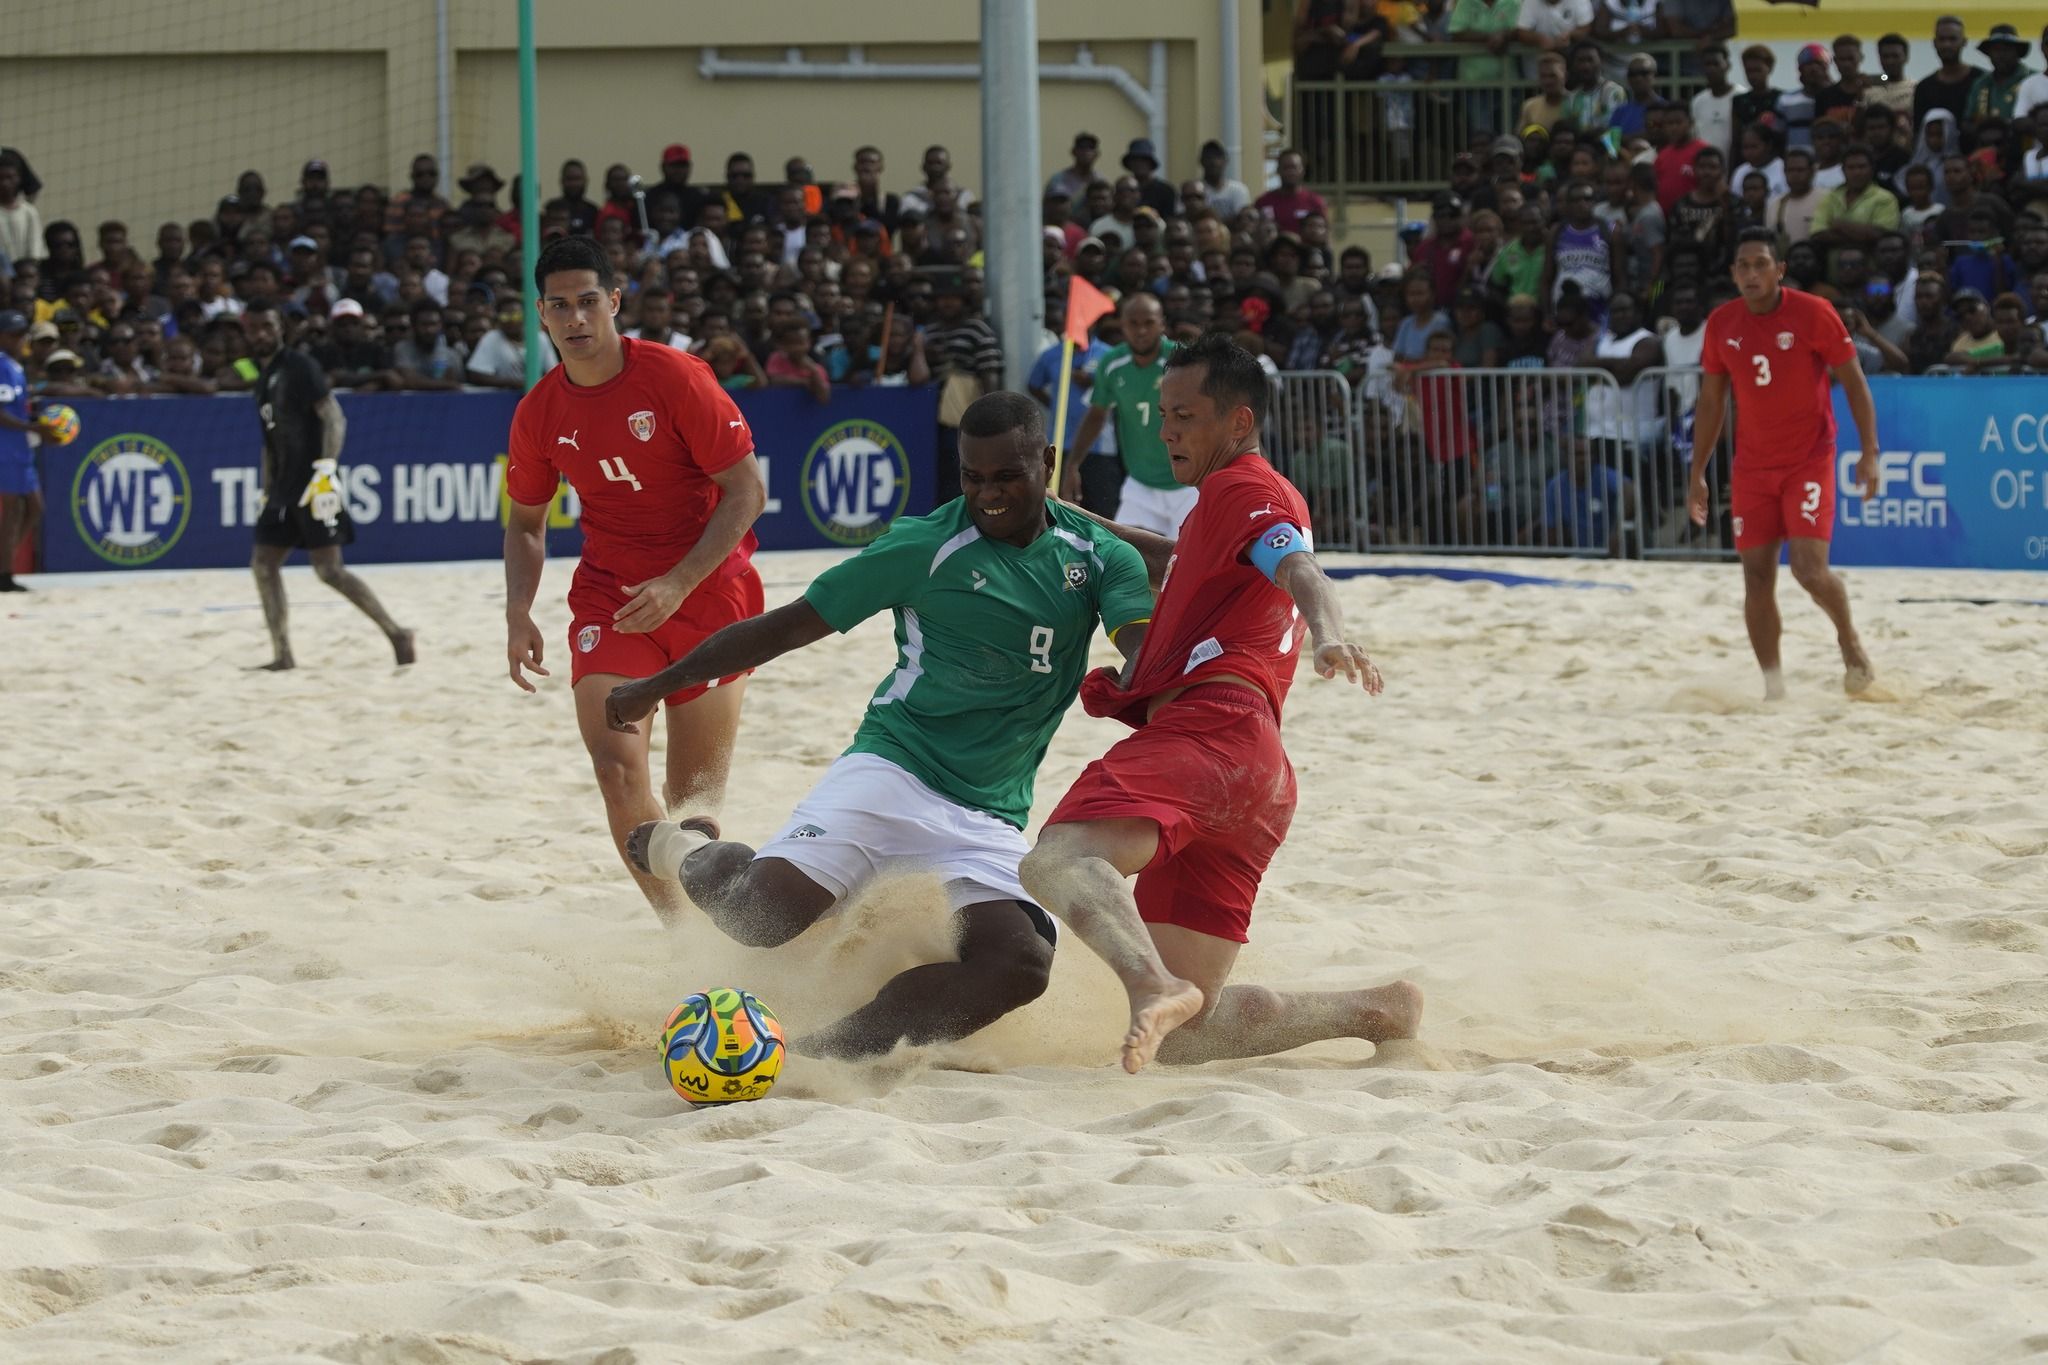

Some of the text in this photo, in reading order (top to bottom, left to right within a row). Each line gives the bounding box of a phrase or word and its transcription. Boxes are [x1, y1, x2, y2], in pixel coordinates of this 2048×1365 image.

[1752, 354, 1772, 386] 3
[1136, 402, 1150, 427] 7
[1980, 417, 2004, 453] A
[598, 456, 643, 492] 4
[824, 454, 886, 515] WE
[1991, 469, 2034, 509] OF
[97, 469, 163, 532] WE
[393, 462, 503, 523] HOW
[1801, 481, 1821, 512] 3
[1842, 499, 1947, 528] LEARN
[1030, 625, 1054, 674] 9
